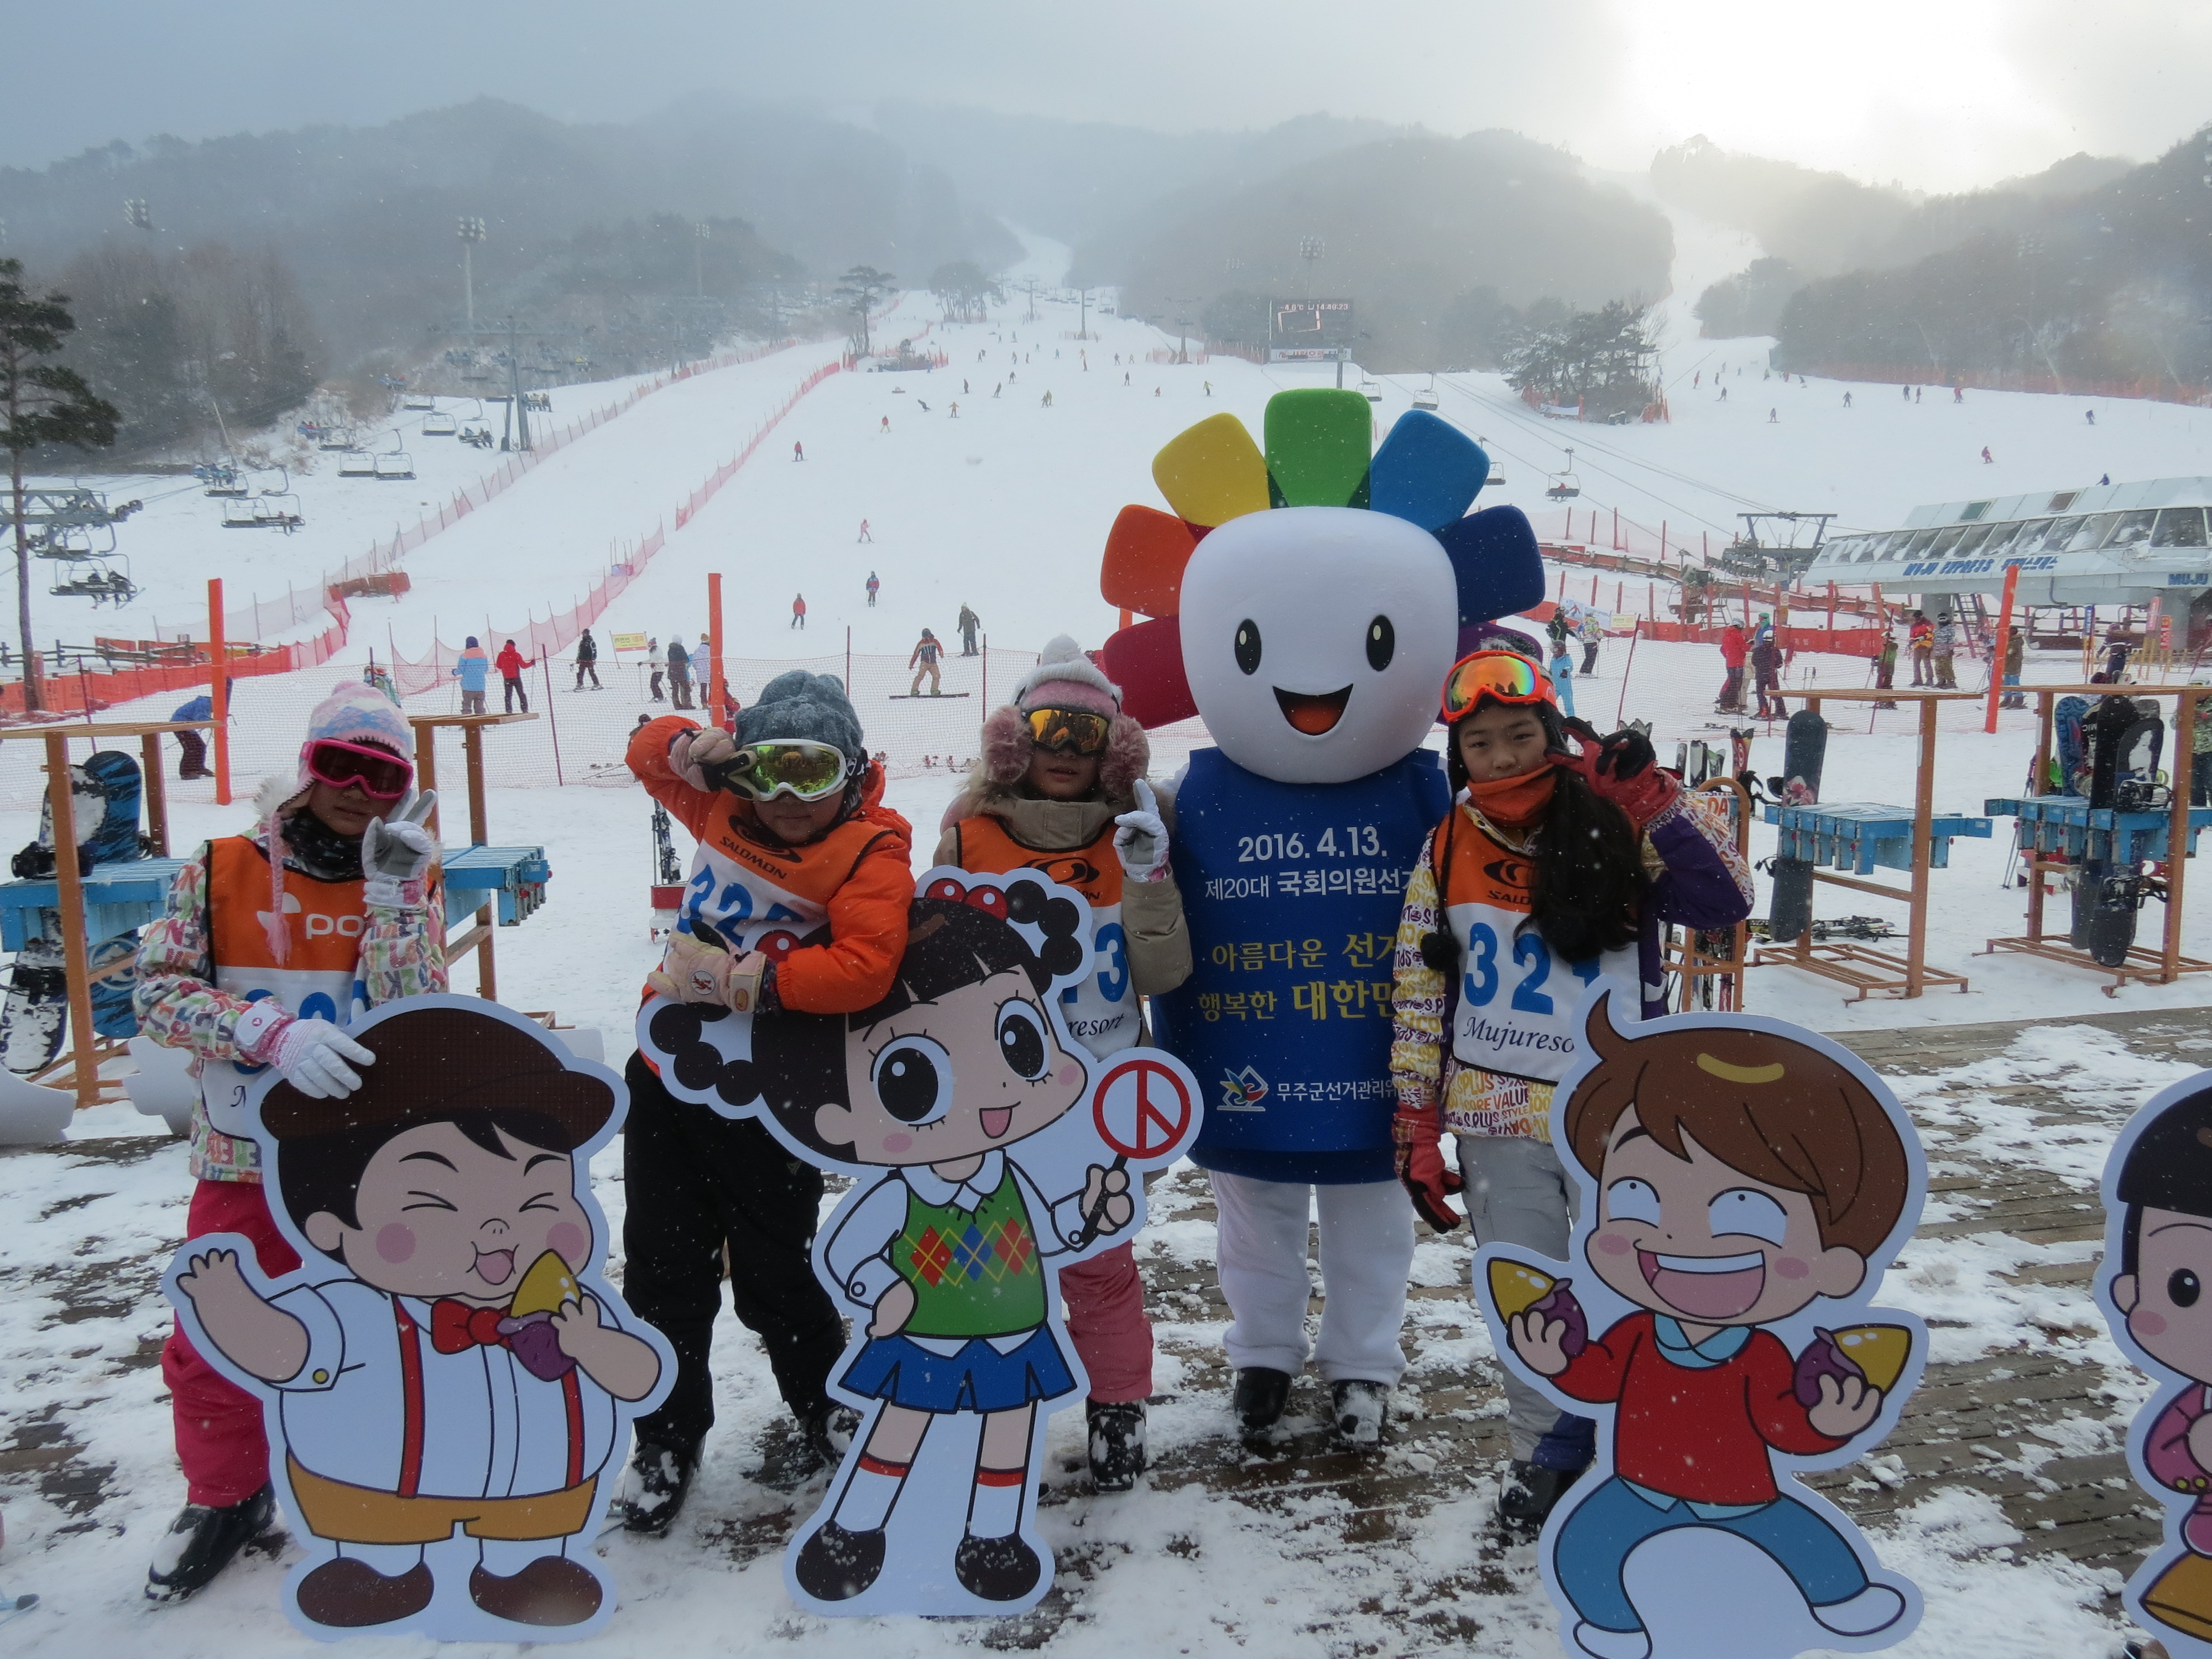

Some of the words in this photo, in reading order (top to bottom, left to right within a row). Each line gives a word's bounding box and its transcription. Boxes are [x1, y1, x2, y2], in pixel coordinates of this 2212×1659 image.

[1902, 562, 1939, 576] MUJU
[1939, 559, 1995, 574] EXPRESS
[2168, 573, 2208, 585] MUJU
[719, 836, 787, 879] SALOMON
[1238, 832, 1310, 863] 2016.
[1317, 826, 1387, 858] 4.13.
[1205, 874, 1269, 900] 제20대
[1488, 890, 1531, 905] SALO
[306, 913, 364, 940] po
[1212, 938, 1328, 972] 아름다운
[1198, 990, 1278, 1022] 행복한
[1291, 980, 1394, 1021] 대한민
[1067, 1013, 1125, 1037] resort
[1463, 1016, 1575, 1053] Mujureso
[1277, 1079, 1397, 1102] 무주군선거관리위
